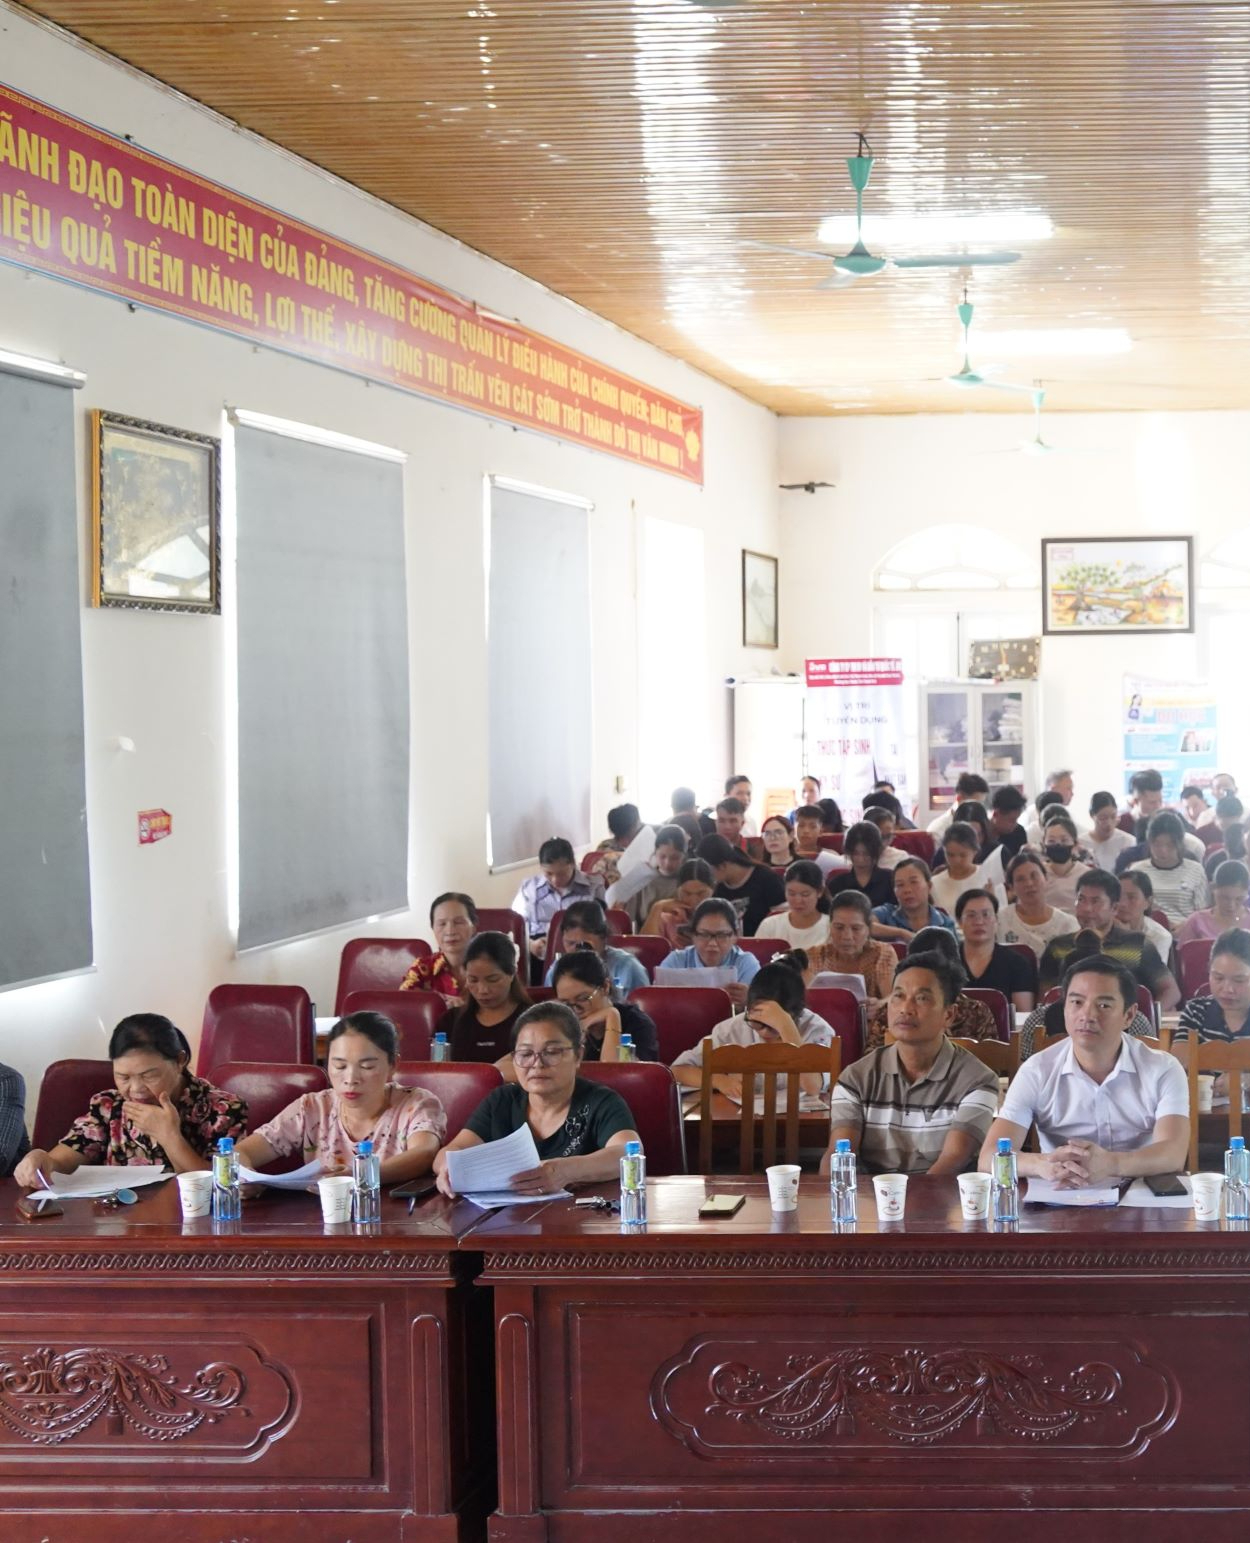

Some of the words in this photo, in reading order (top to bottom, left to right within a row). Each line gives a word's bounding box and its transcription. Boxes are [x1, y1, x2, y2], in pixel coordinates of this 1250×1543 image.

[61, 214, 117, 274] QUẢ
[124, 237, 184, 297] TIỀM
[192, 263, 259, 327] NĂNG,
[265, 291, 296, 339] LỢI
[345, 320, 377, 362] XÂY
[382, 336, 423, 378] DỰNG
[426, 352, 448, 393] THỊ
[450, 360, 485, 401] TRẤN
[487, 373, 511, 409] YÊN
[512, 383, 534, 417] CÁT
[536, 389, 561, 427] SỚM
[561, 398, 582, 434] TRỞ
[68, 149, 123, 211] ĐẠO
[131, 176, 196, 240] TOÀN
[202, 210, 254, 264] DIỆN
[260, 224, 300, 281] CỦA
[305, 243, 360, 308] ĐẢNG,
[364, 274, 406, 323] TĂNG
[410, 297, 457, 344] CƯỜNG
[496, 332, 509, 365] LÝ
[540, 351, 568, 390] HÀNH
[570, 360, 590, 399] CỦA
